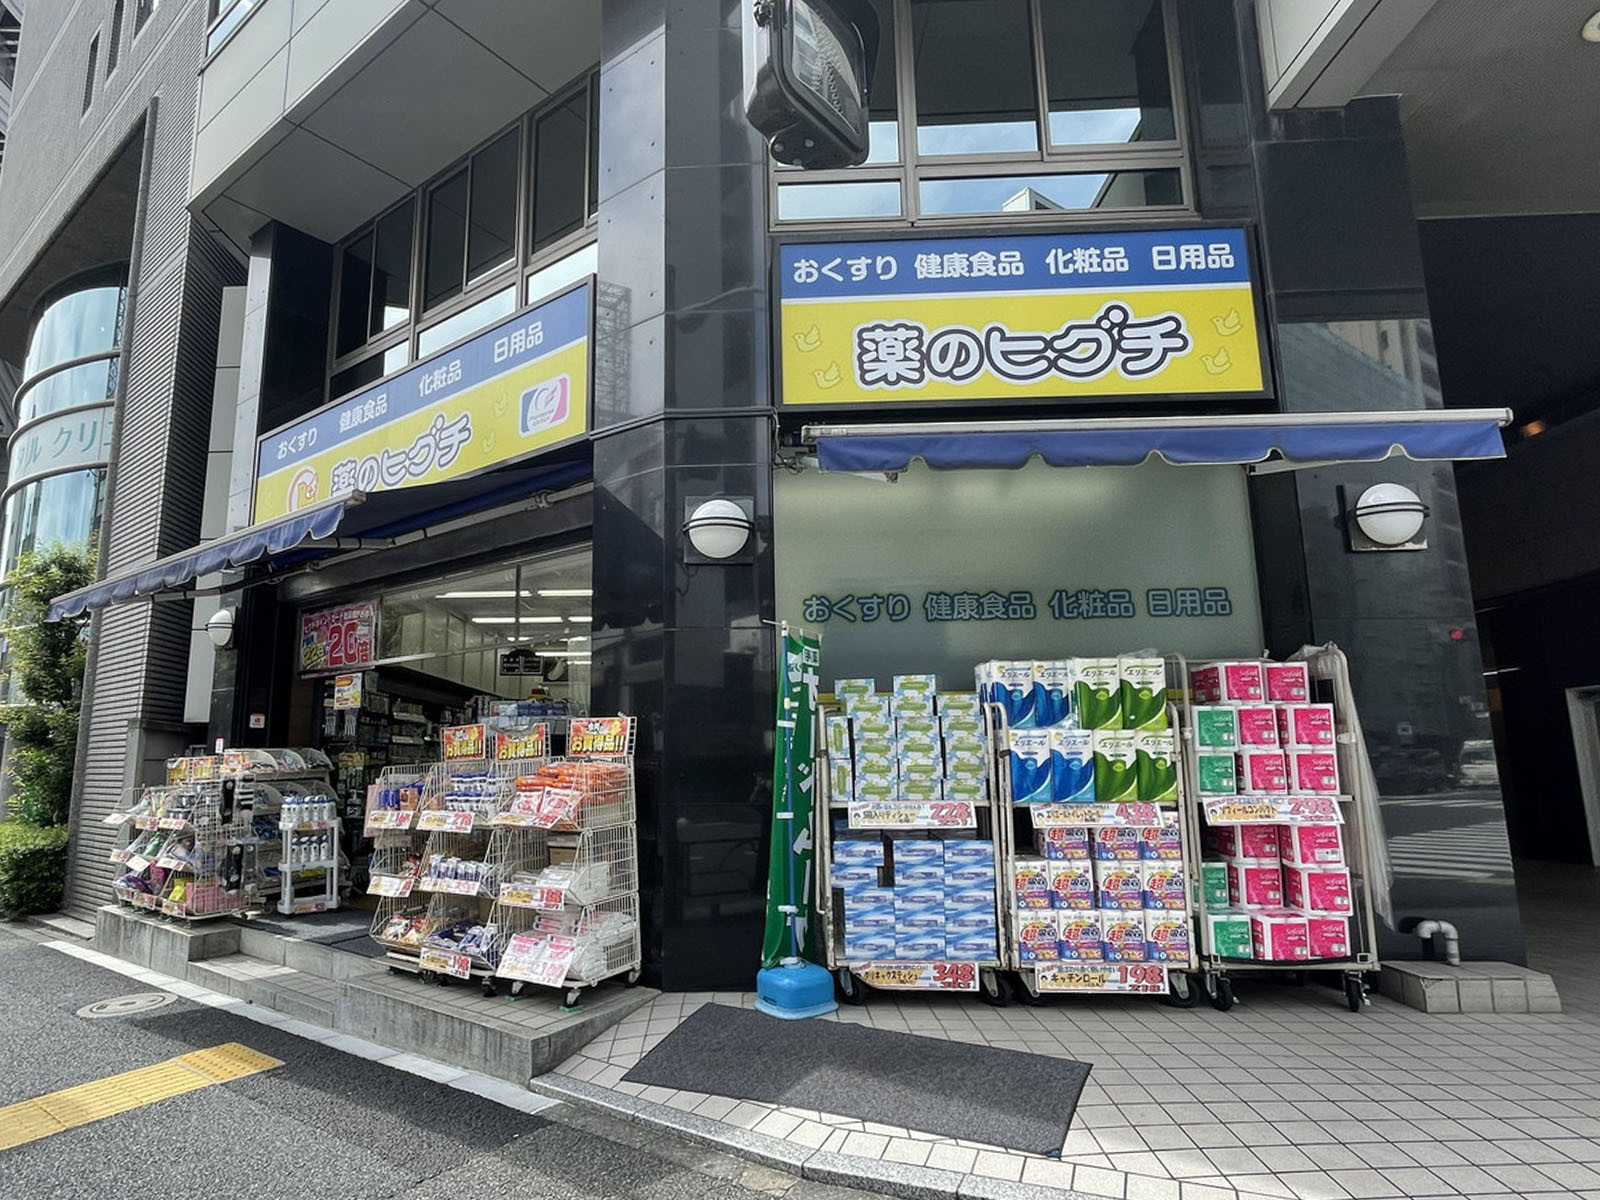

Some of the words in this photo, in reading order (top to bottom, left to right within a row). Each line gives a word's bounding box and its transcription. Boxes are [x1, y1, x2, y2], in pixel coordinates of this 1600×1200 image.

[793, 255, 897, 283] おくすり
[914, 251, 1025, 279] 健康食品
[1045, 247, 1129, 275] 化粧品
[1151, 243, 1235, 271] 日用品
[856, 303, 1189, 385] 薬のヒグチ
[277, 427, 317, 460] おくすり
[339, 394, 388, 433] 健康食品
[418, 360, 462, 397] 化粧品
[494, 321, 543, 363] 日用品
[331, 413, 472, 496] 薬のヒグチ
[803, 594, 910, 623] おくすり
[923, 590, 1036, 622] 健康食品
[1048, 589, 1135, 619] 化粧品
[1146, 588, 1231, 617] 日用品
[929, 802, 970, 820] 228
[933, 963, 974, 983] 348
[1051, 973, 1106, 983] キッチンロール
[1118, 965, 1162, 984] 198
